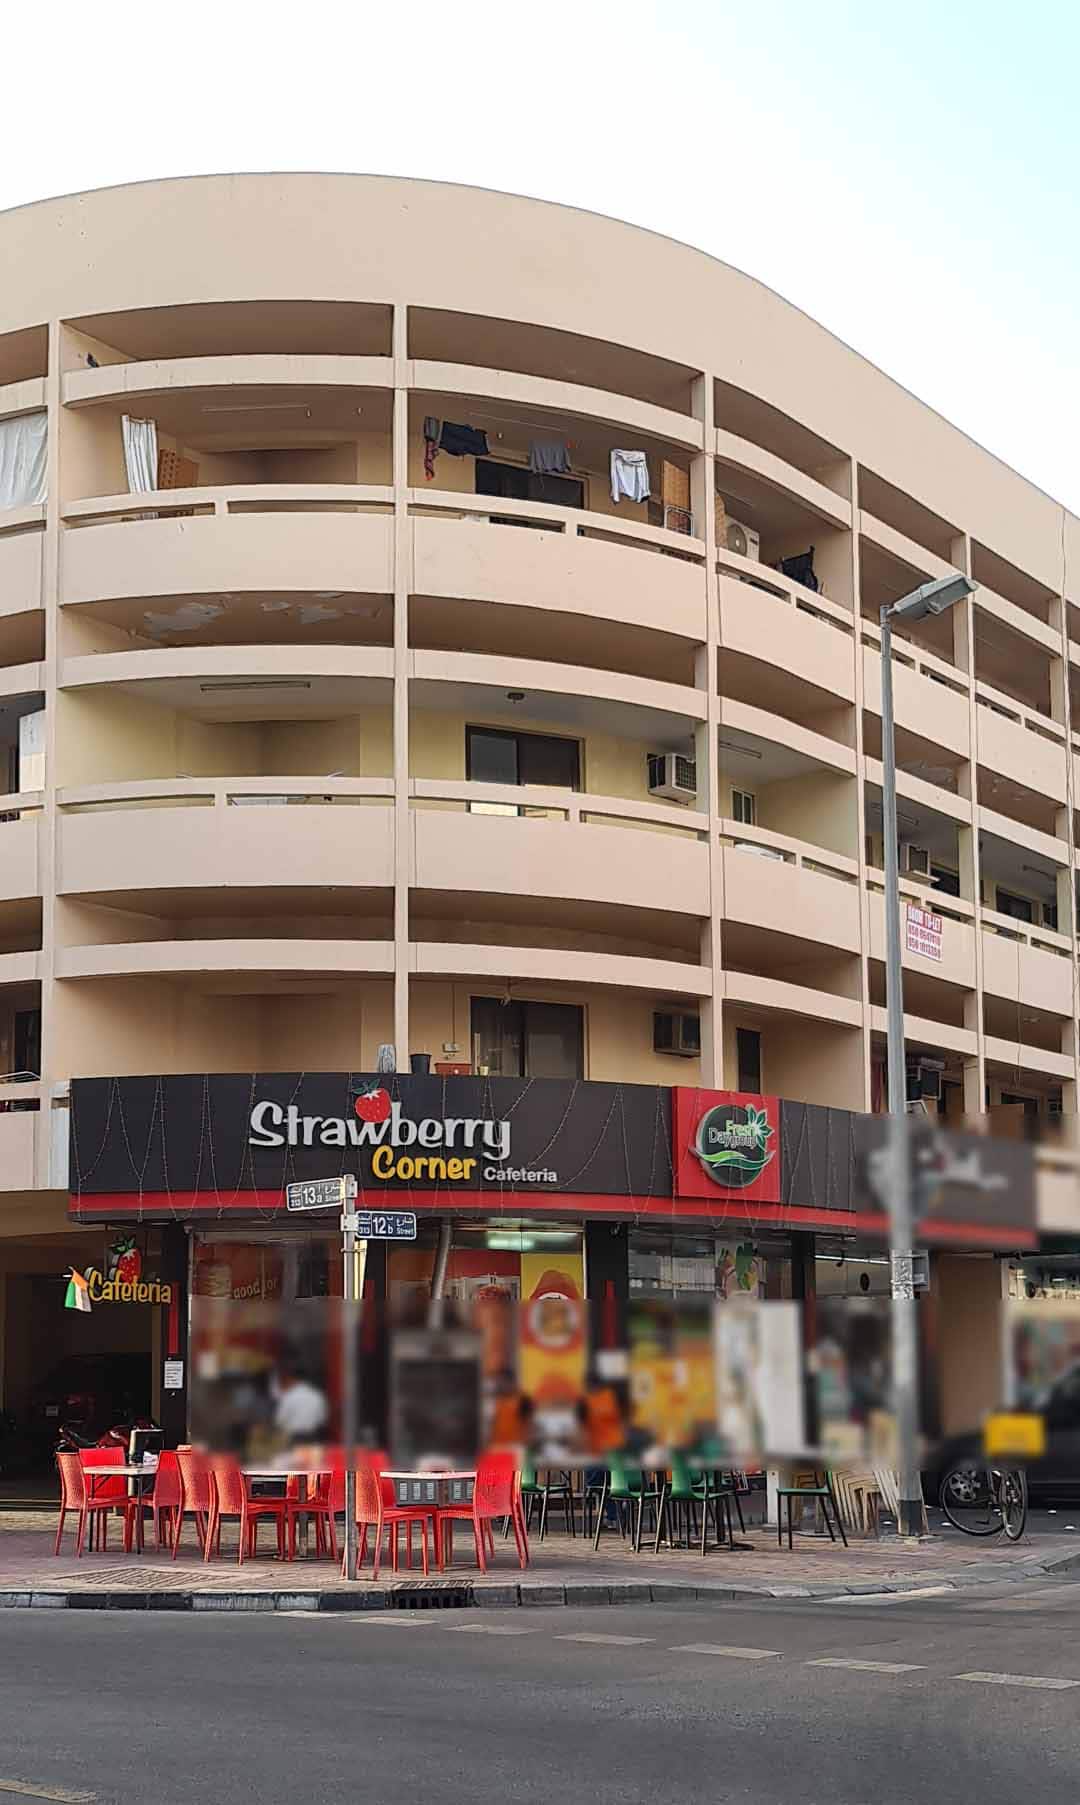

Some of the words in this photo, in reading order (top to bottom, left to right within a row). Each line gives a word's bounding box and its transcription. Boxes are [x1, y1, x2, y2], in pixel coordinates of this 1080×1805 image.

[249, 1100, 511, 1160] Strawberry
[725, 1120, 757, 1136] Fresh
[372, 1145, 477, 1180] Corner
[484, 1167, 558, 1182] Cafeteria
[396, 1227, 414, 1236] Street
[88, 1270, 172, 1304] Cafeteria
